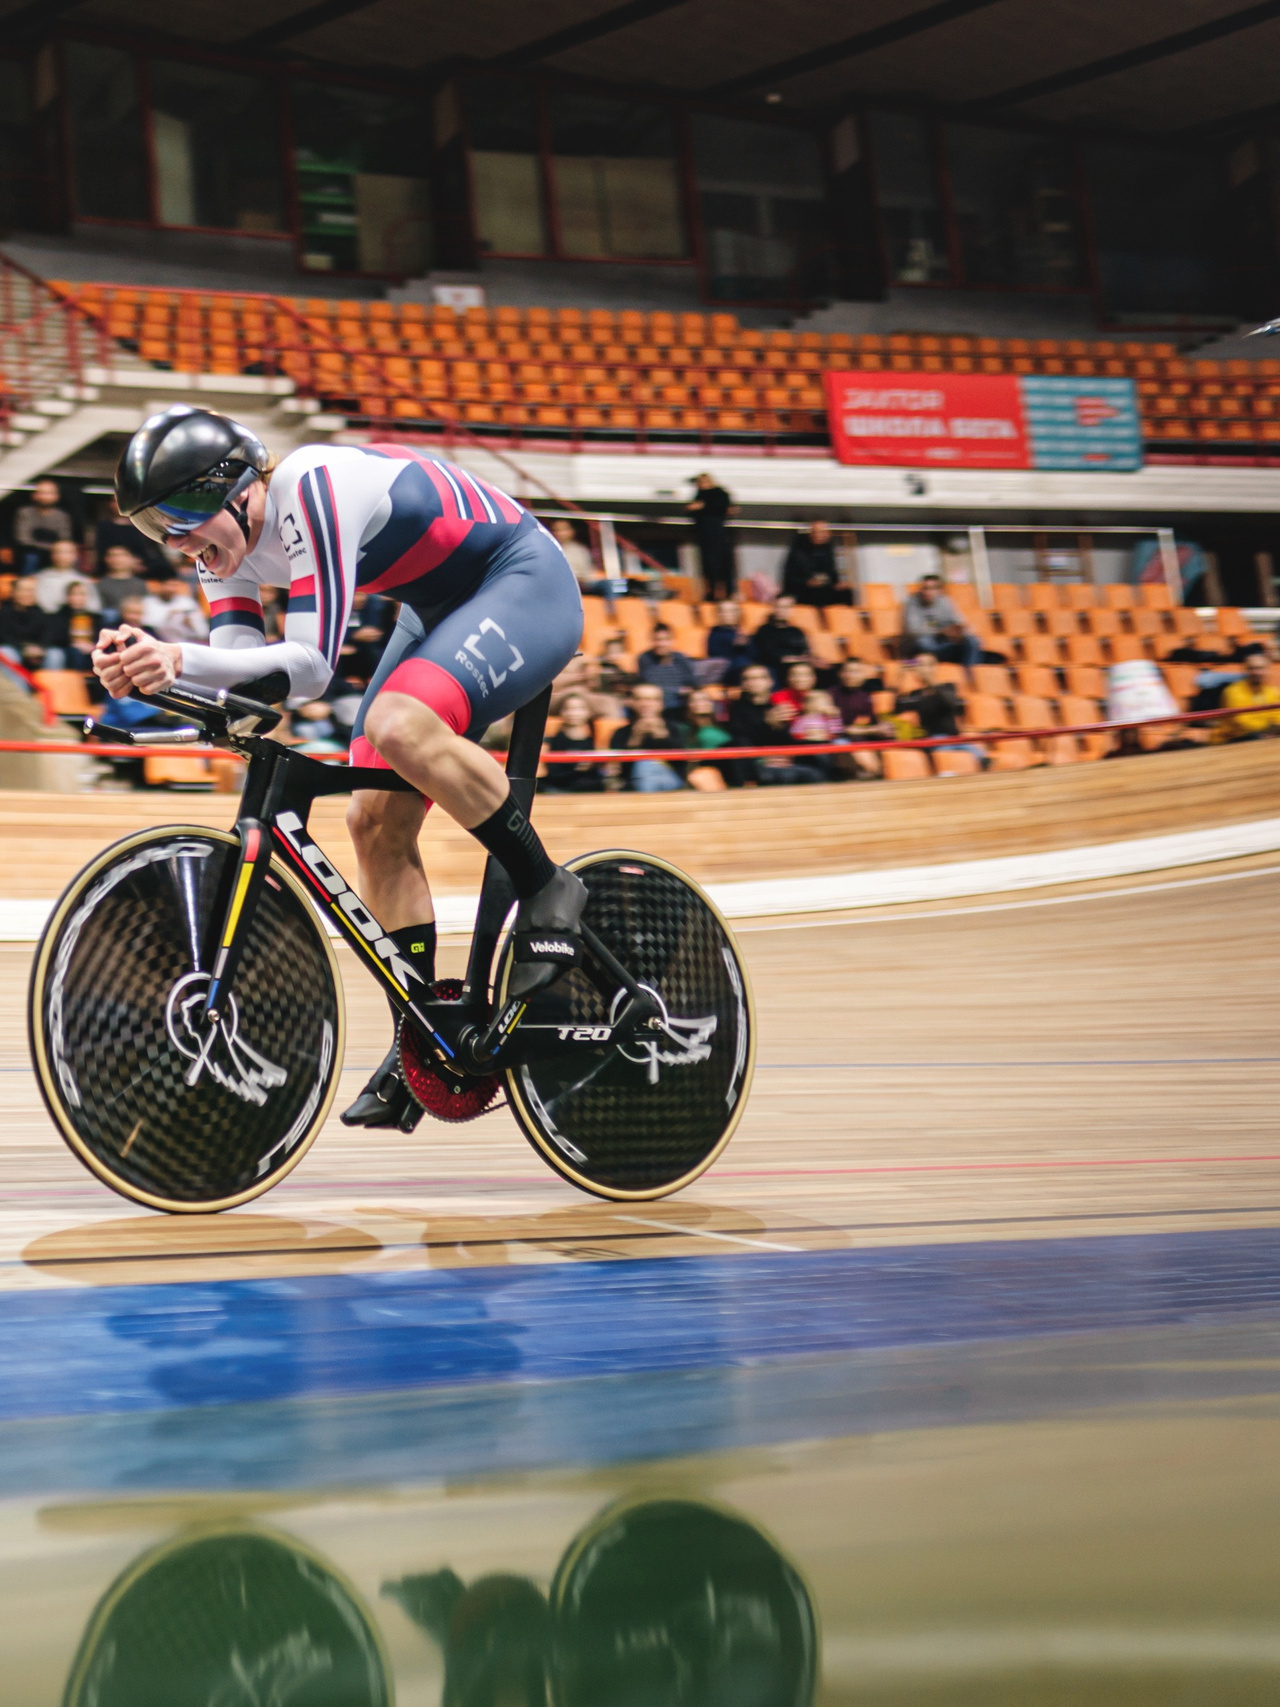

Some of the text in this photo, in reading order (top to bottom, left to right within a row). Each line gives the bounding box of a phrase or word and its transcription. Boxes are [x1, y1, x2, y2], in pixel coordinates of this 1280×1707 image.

[455, 649, 489, 699] Rostec
[275, 811, 426, 992] LOOK
[529, 941, 575, 957] Velobike
[557, 1027, 613, 1041] T20
